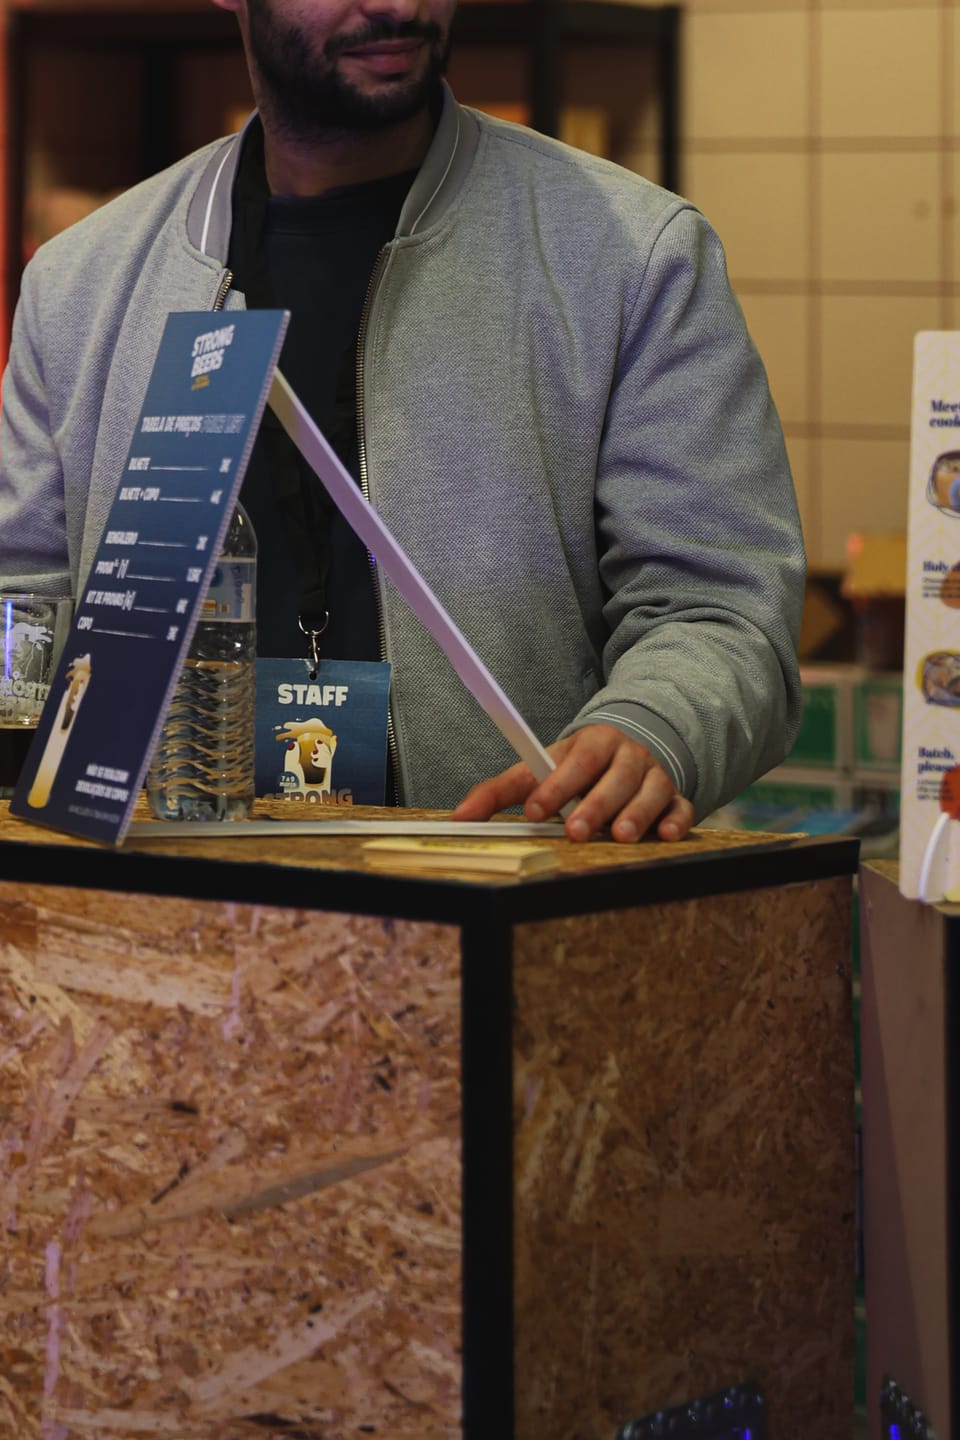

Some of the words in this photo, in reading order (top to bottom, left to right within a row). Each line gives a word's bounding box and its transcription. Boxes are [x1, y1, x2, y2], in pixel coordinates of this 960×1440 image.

[192, 324, 235, 357] STRONG
[191, 348, 225, 378] BEERS
[277, 683, 349, 706] STAFF
